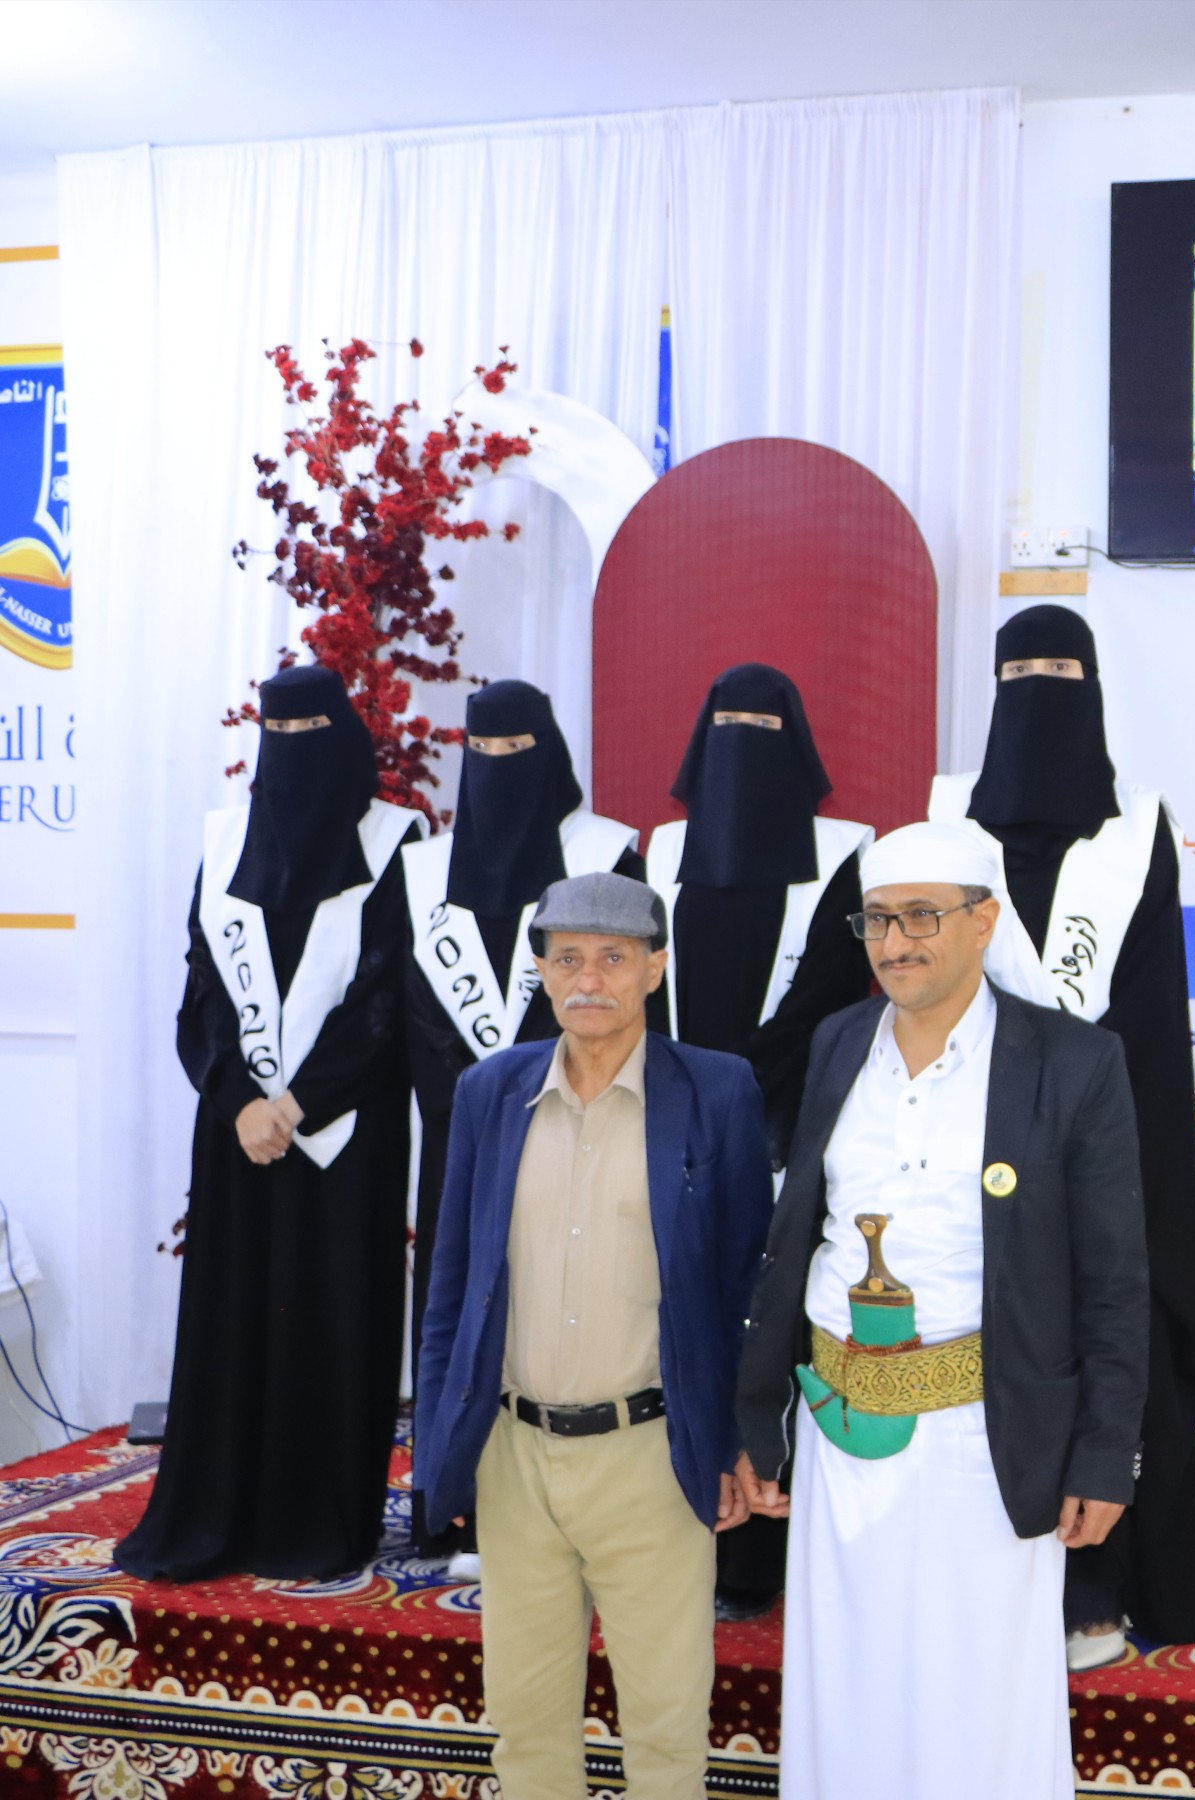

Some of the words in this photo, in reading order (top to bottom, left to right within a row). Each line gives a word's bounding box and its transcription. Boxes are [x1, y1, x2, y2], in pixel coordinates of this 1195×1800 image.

[0, 379, 43, 404] الناص
[223, 919, 278, 1079] 2026
[427, 901, 500, 1048] 2026
